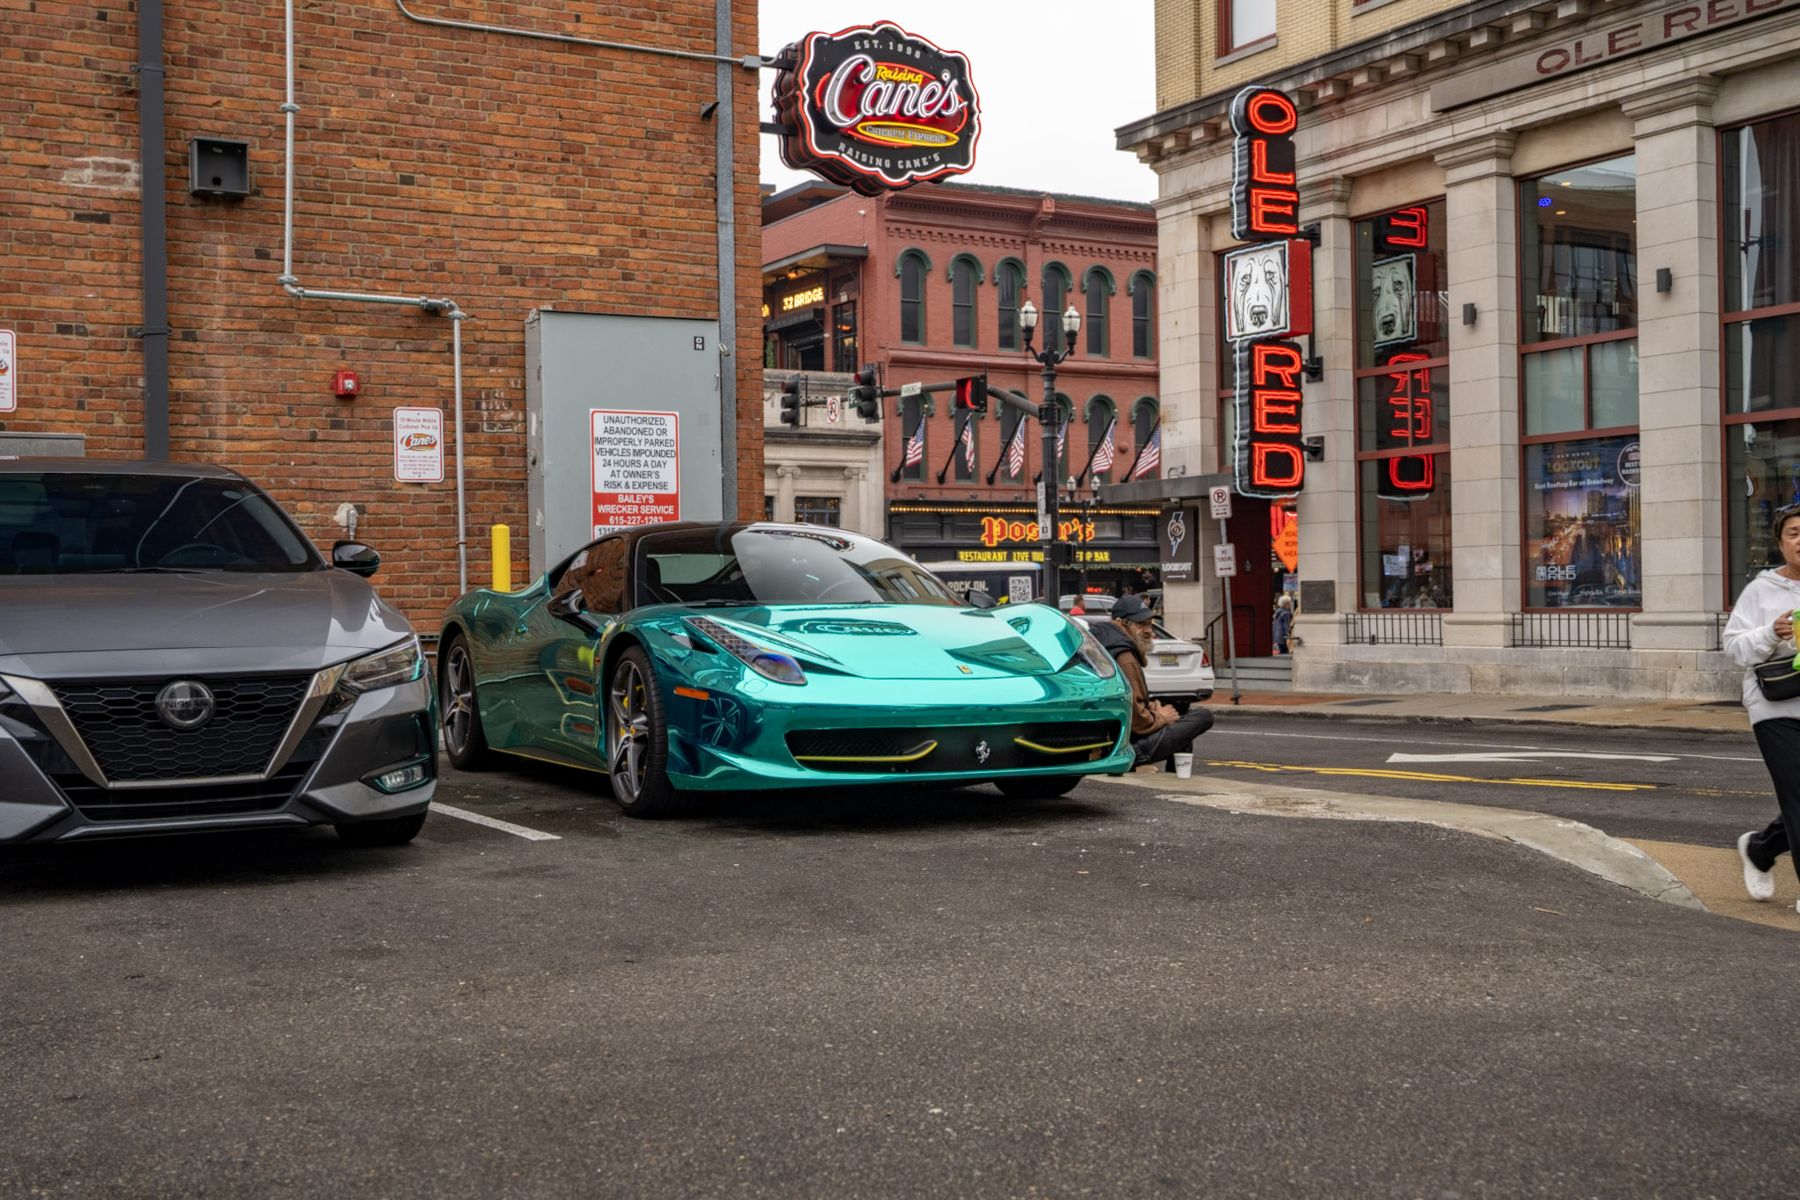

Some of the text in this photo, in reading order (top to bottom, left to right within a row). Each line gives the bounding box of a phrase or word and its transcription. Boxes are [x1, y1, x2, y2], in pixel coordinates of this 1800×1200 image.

[854, 40, 883, 50] EST.
[1536, 22, 1643, 75] OLE
[876, 65, 923, 85] Raising
[825, 54, 968, 127] Cane's
[838, 142, 940, 170] RAISING CANE'S
[1248, 92, 1299, 234] OLE
[794, 286, 825, 308] BRIDGE
[603, 415, 667, 427] UNAUTHORIZED,
[1253, 345, 1304, 487] RED
[604, 426, 668, 436] ABANDONED OR
[595, 437, 675, 447] IMPROPERLY PARKED
[595, 447, 676, 458] VEHICLES IMPOUNDED
[602, 458, 667, 469] 24 HOURS A DAY
[1547, 458, 1600, 473] LOOKOUT
[610, 469, 660, 479] AT OWNER'S
[604, 480, 669, 490] RISK & EXPENSE
[618, 494, 654, 504] BAILEY'S
[597, 504, 674, 514] WRECKER SERVICE
[959, 551, 1007, 562] RESTAURANT
[1012, 551, 1030, 562] LIVE
[1094, 551, 1110, 562] BAR
[1161, 562, 1193, 572] LOOKOUT
[1547, 565, 1576, 573] OLE
[973, 580, 989, 591] ON.
